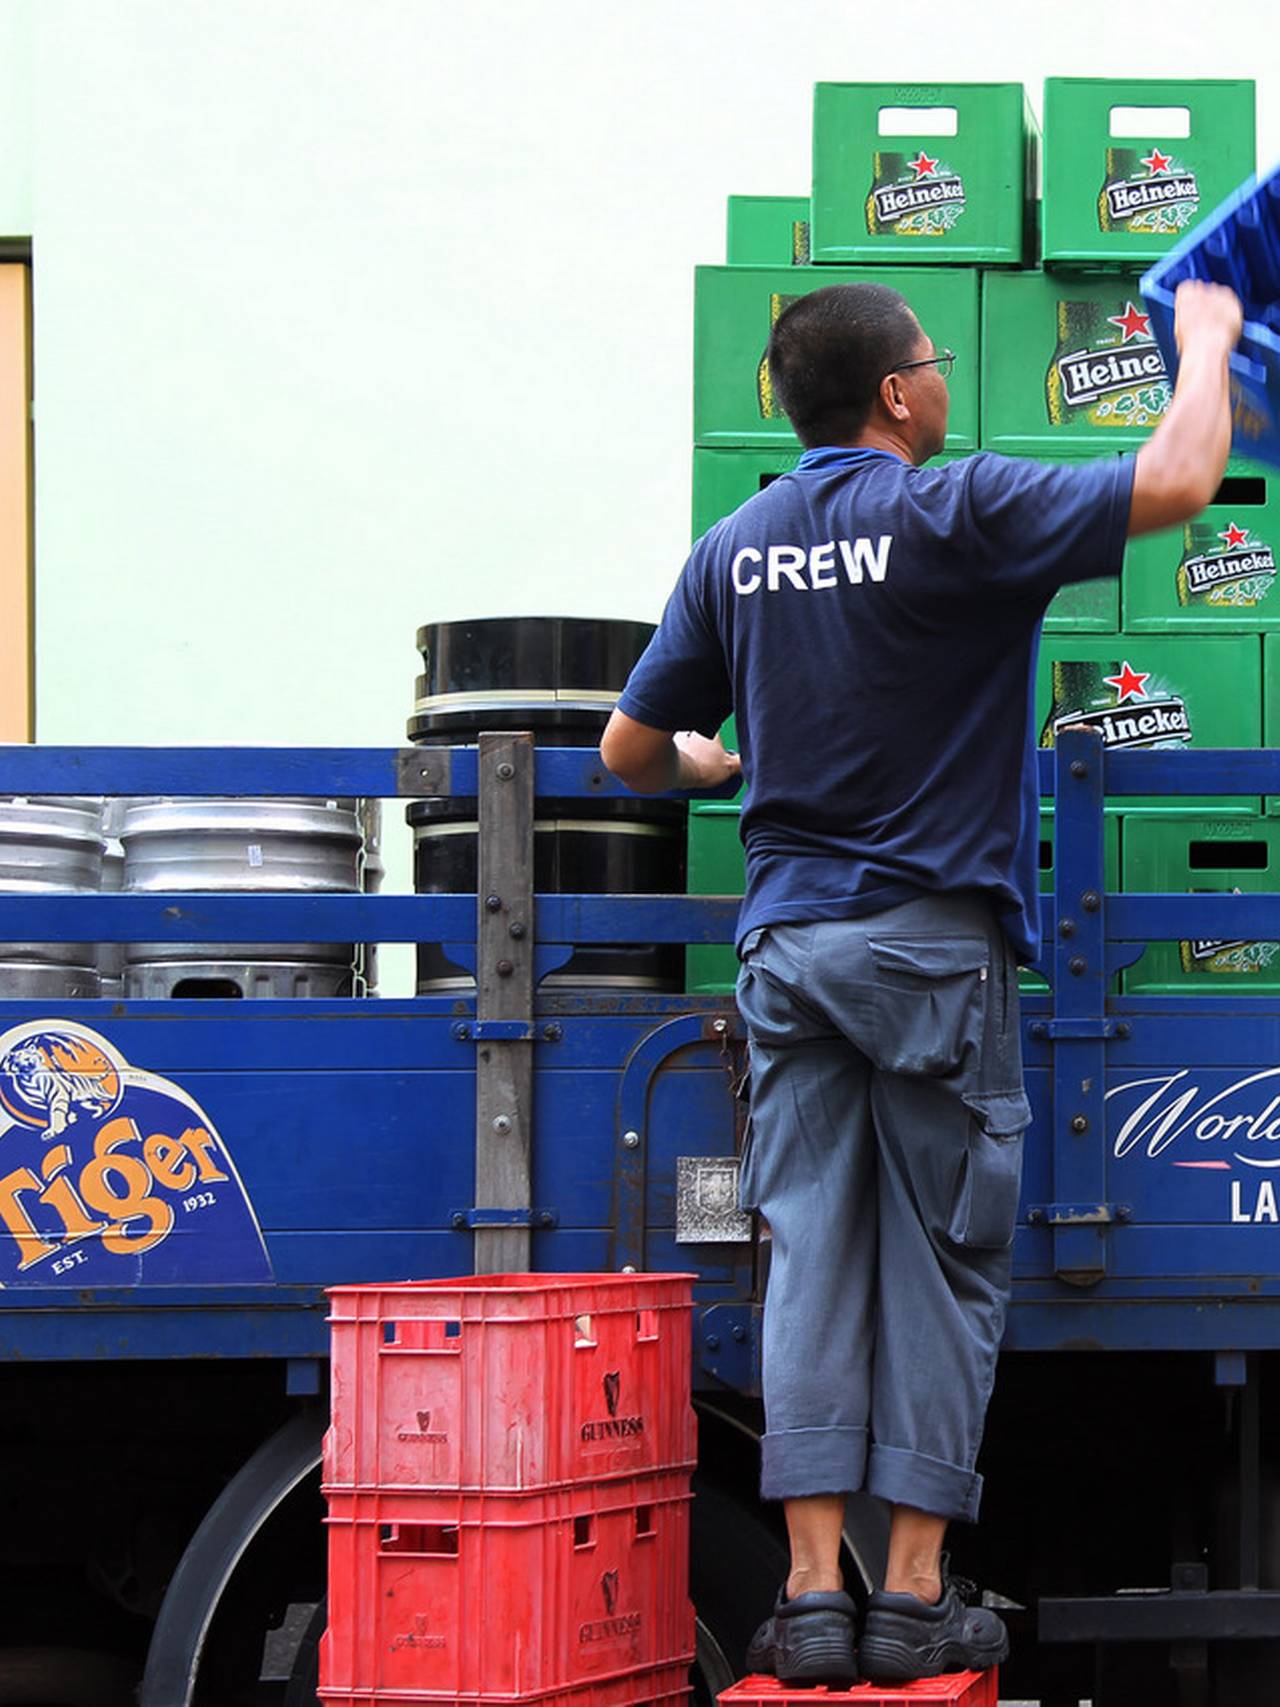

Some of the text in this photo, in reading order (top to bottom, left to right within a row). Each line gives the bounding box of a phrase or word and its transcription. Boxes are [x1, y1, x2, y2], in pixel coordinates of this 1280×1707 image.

[1068, 349, 1166, 392] Heine
[732, 535, 893, 595] CREW
[0, 1117, 229, 1271] Tiger
[183, 1192, 216, 1213] 1932
